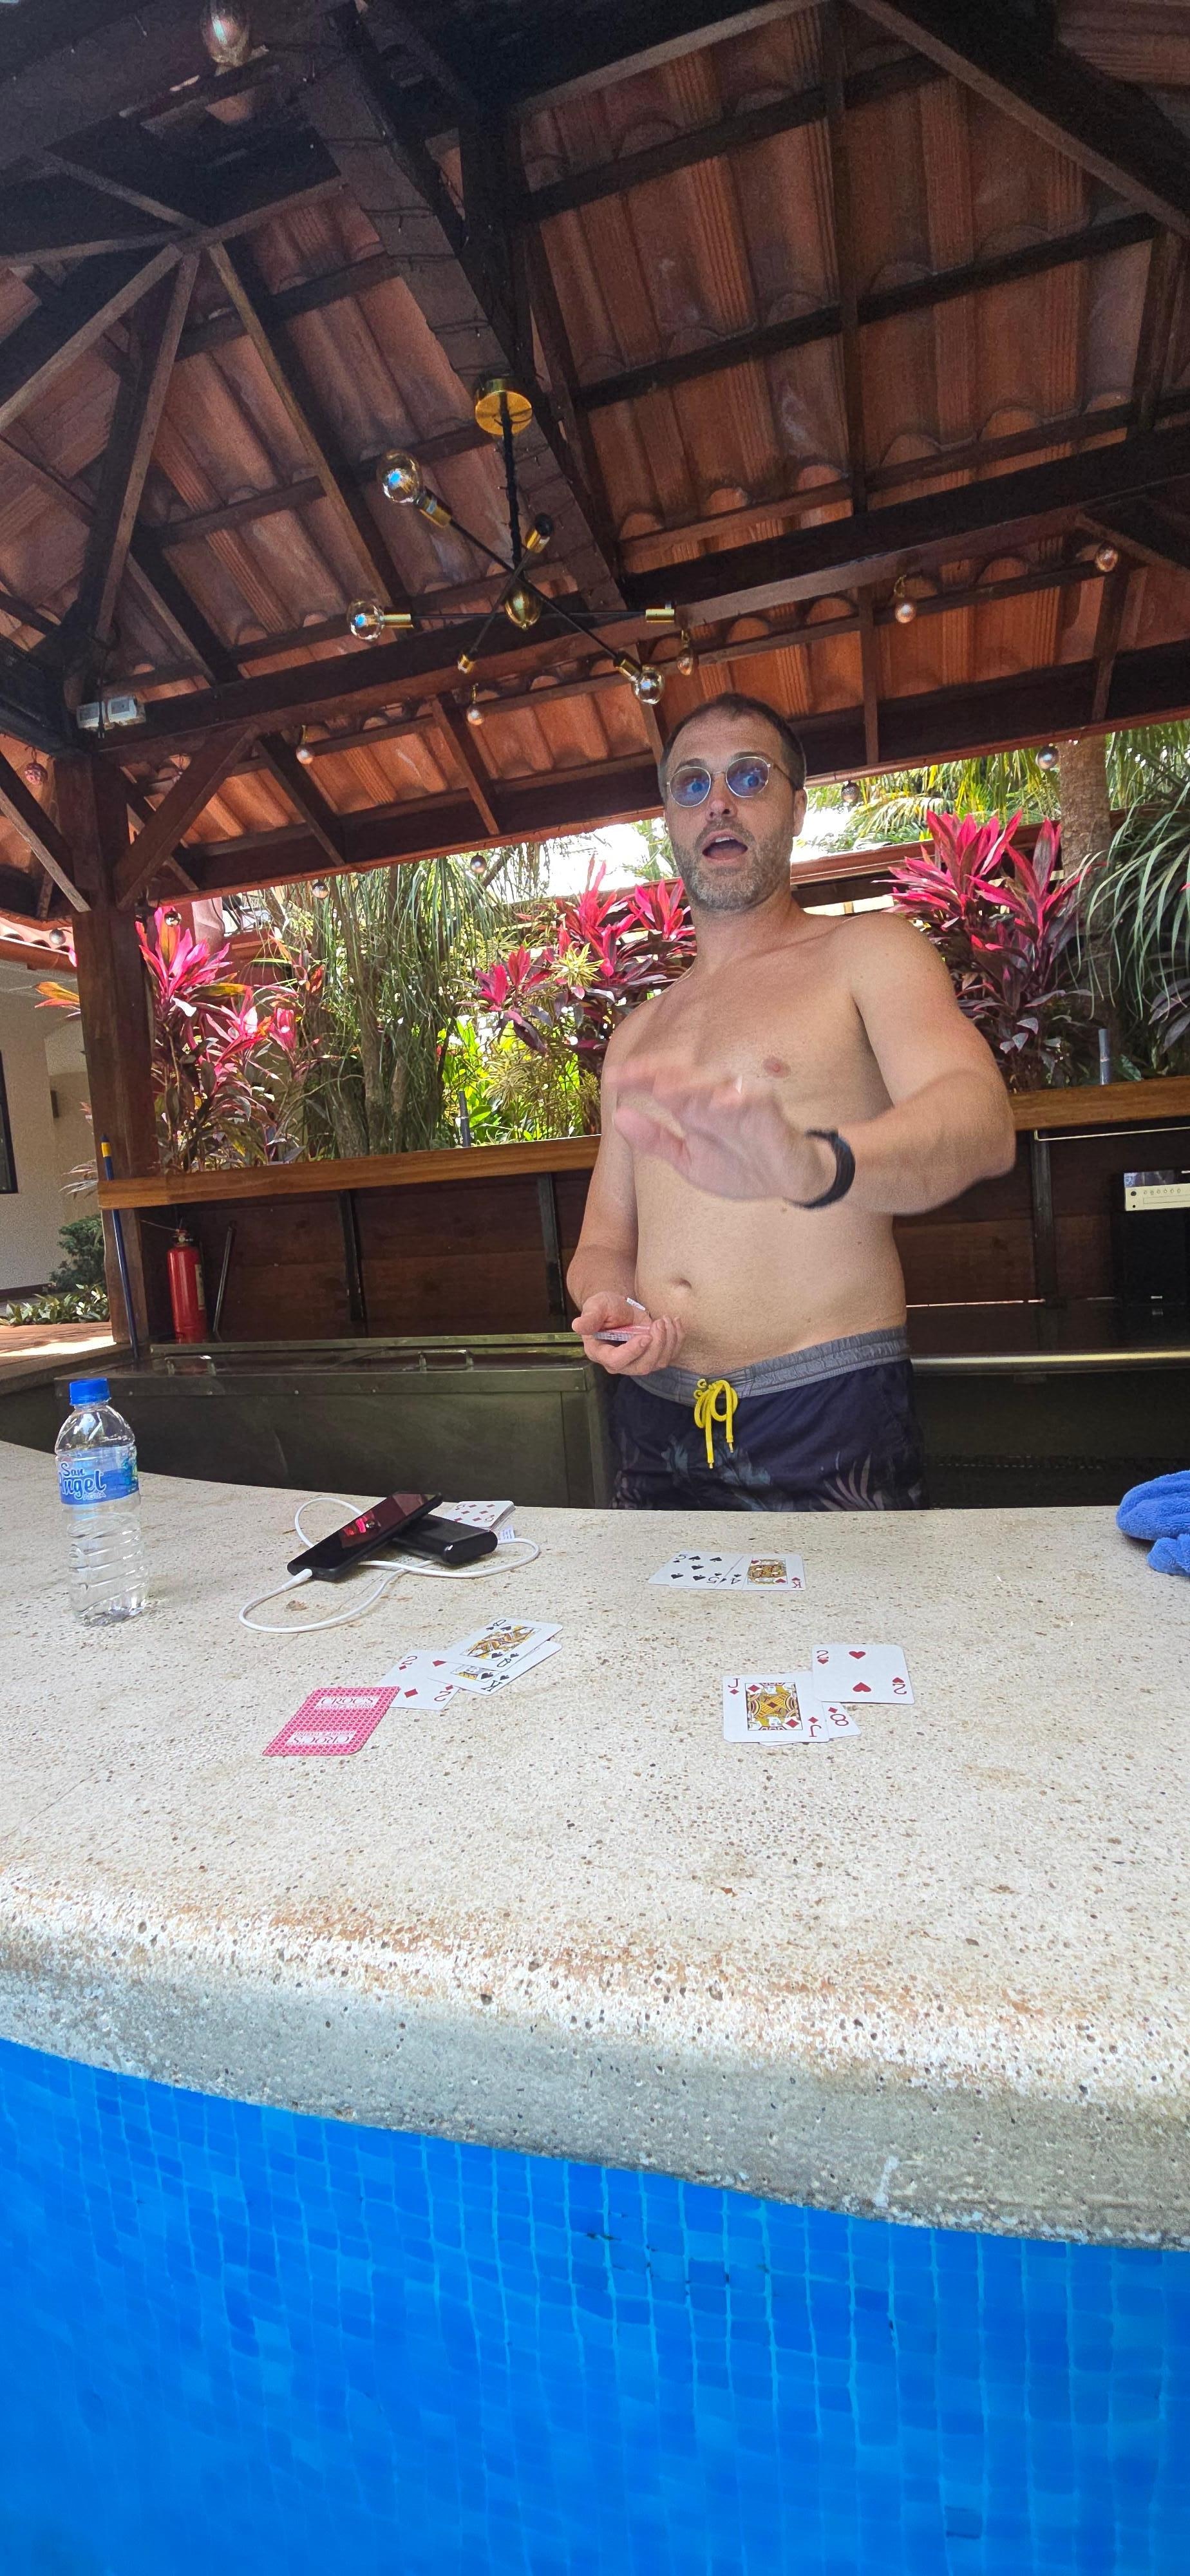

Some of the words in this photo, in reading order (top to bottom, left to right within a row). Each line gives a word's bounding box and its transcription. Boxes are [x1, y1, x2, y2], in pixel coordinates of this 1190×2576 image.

[61, 1461, 85, 1477] San
[401, 1655, 417, 1665] 2
[817, 1650, 829, 1659] 2
[496, 1658, 512, 1667] Q
[480, 1680, 503, 1692] K
[728, 1678, 741, 1688] J
[892, 1683, 907, 1695] 2
[433, 1690, 451, 1701] 2
[829, 1714, 849, 1727] 8
[808, 1725, 822, 1738] J
